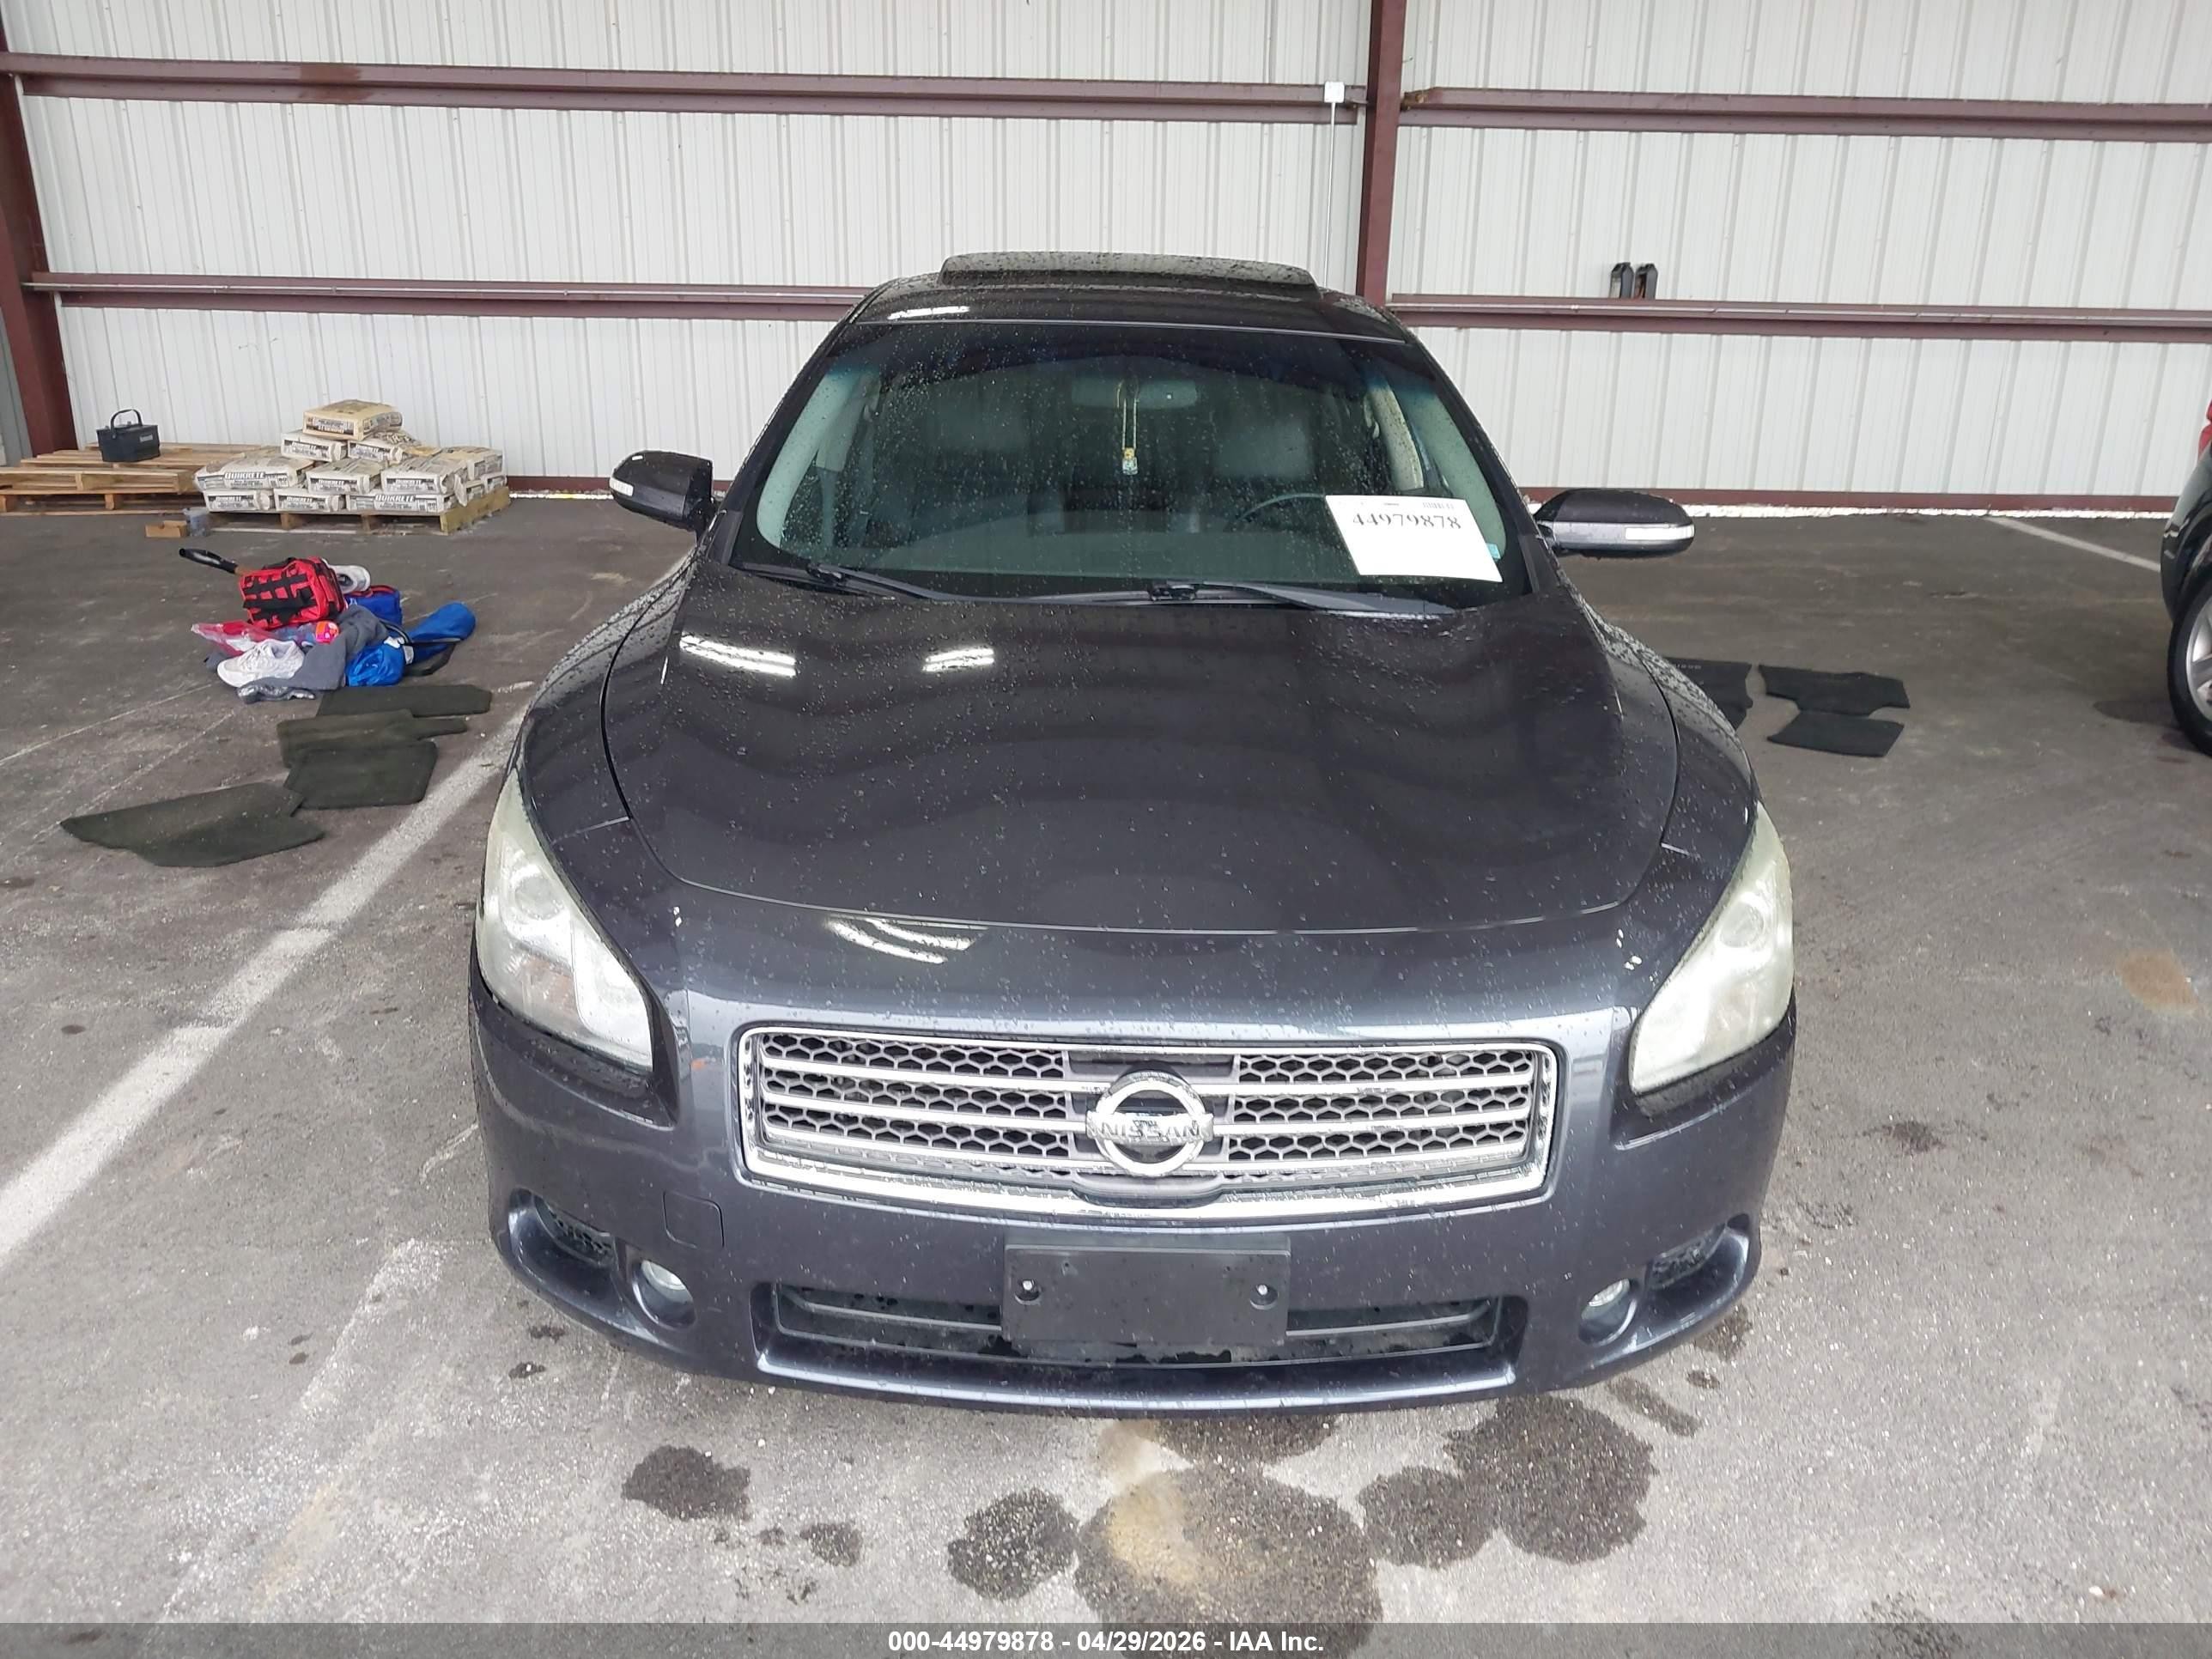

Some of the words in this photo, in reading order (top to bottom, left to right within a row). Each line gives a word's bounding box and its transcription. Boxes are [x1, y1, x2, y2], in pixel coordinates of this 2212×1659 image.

[375, 494, 416, 502] QUIKRETE
[1352, 513, 1462, 530] 44979878
[1100, 1121, 1200, 1142] NISSAN
